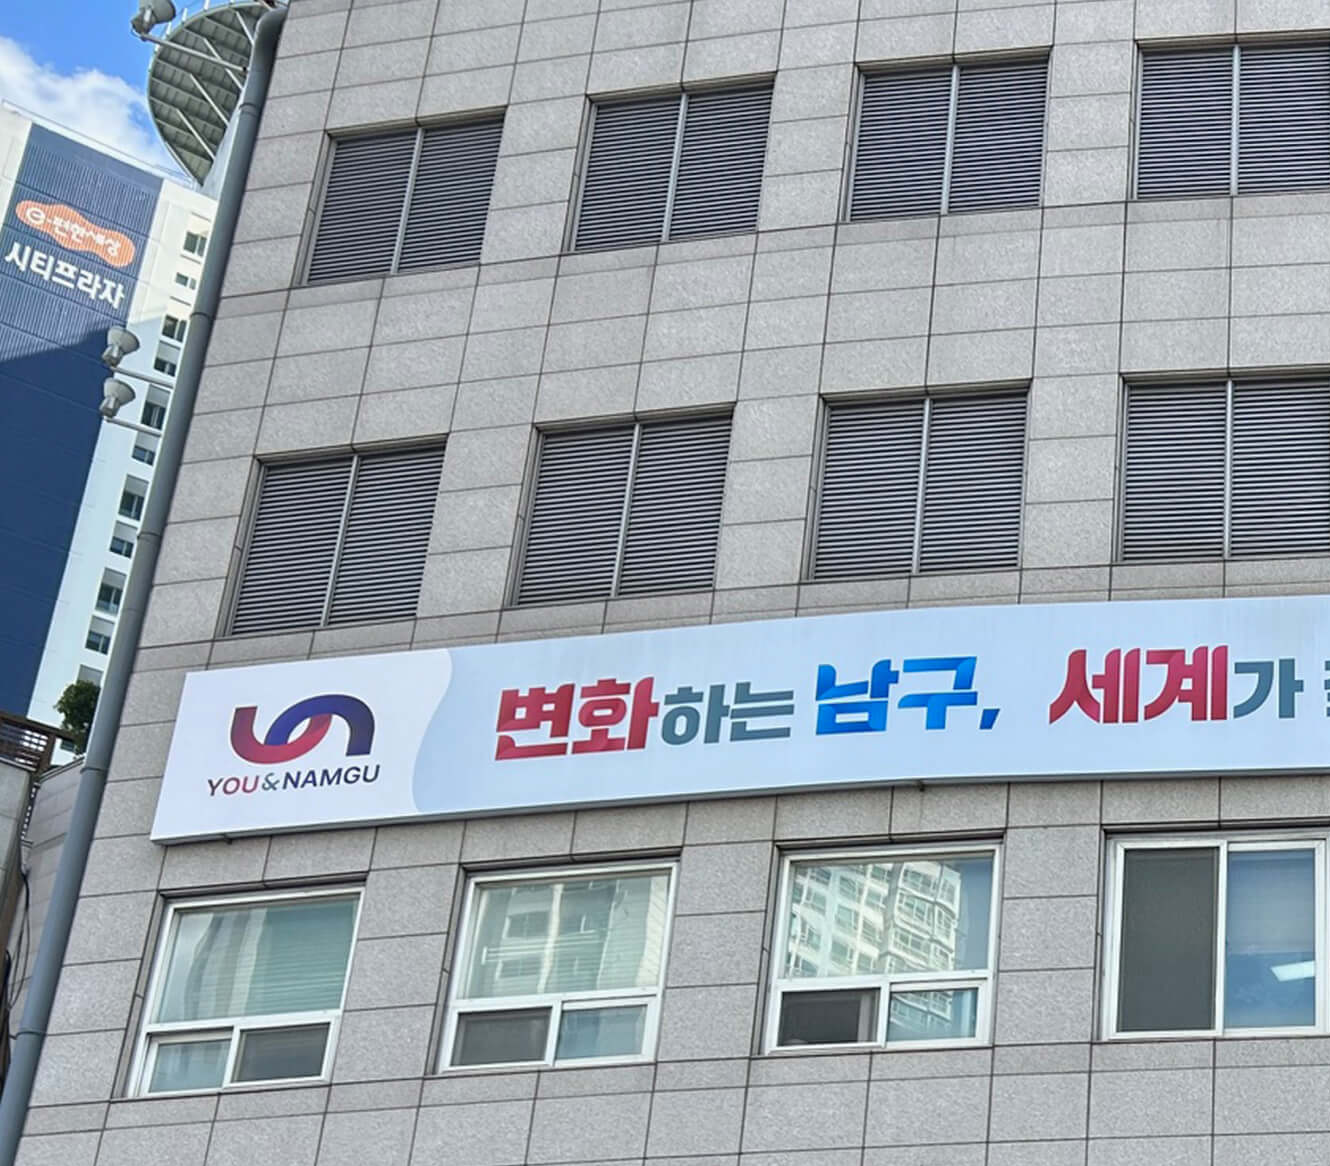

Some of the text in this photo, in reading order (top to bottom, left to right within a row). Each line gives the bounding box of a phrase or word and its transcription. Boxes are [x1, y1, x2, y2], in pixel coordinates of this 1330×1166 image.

[4, 241, 125, 309] 시티프라자
[494, 676, 794, 761] 변화하는
[814, 655, 1000, 737] 남구,
[1048, 644, 1304, 724] 세계가
[207, 764, 381, 797] YOU&NAMGU
